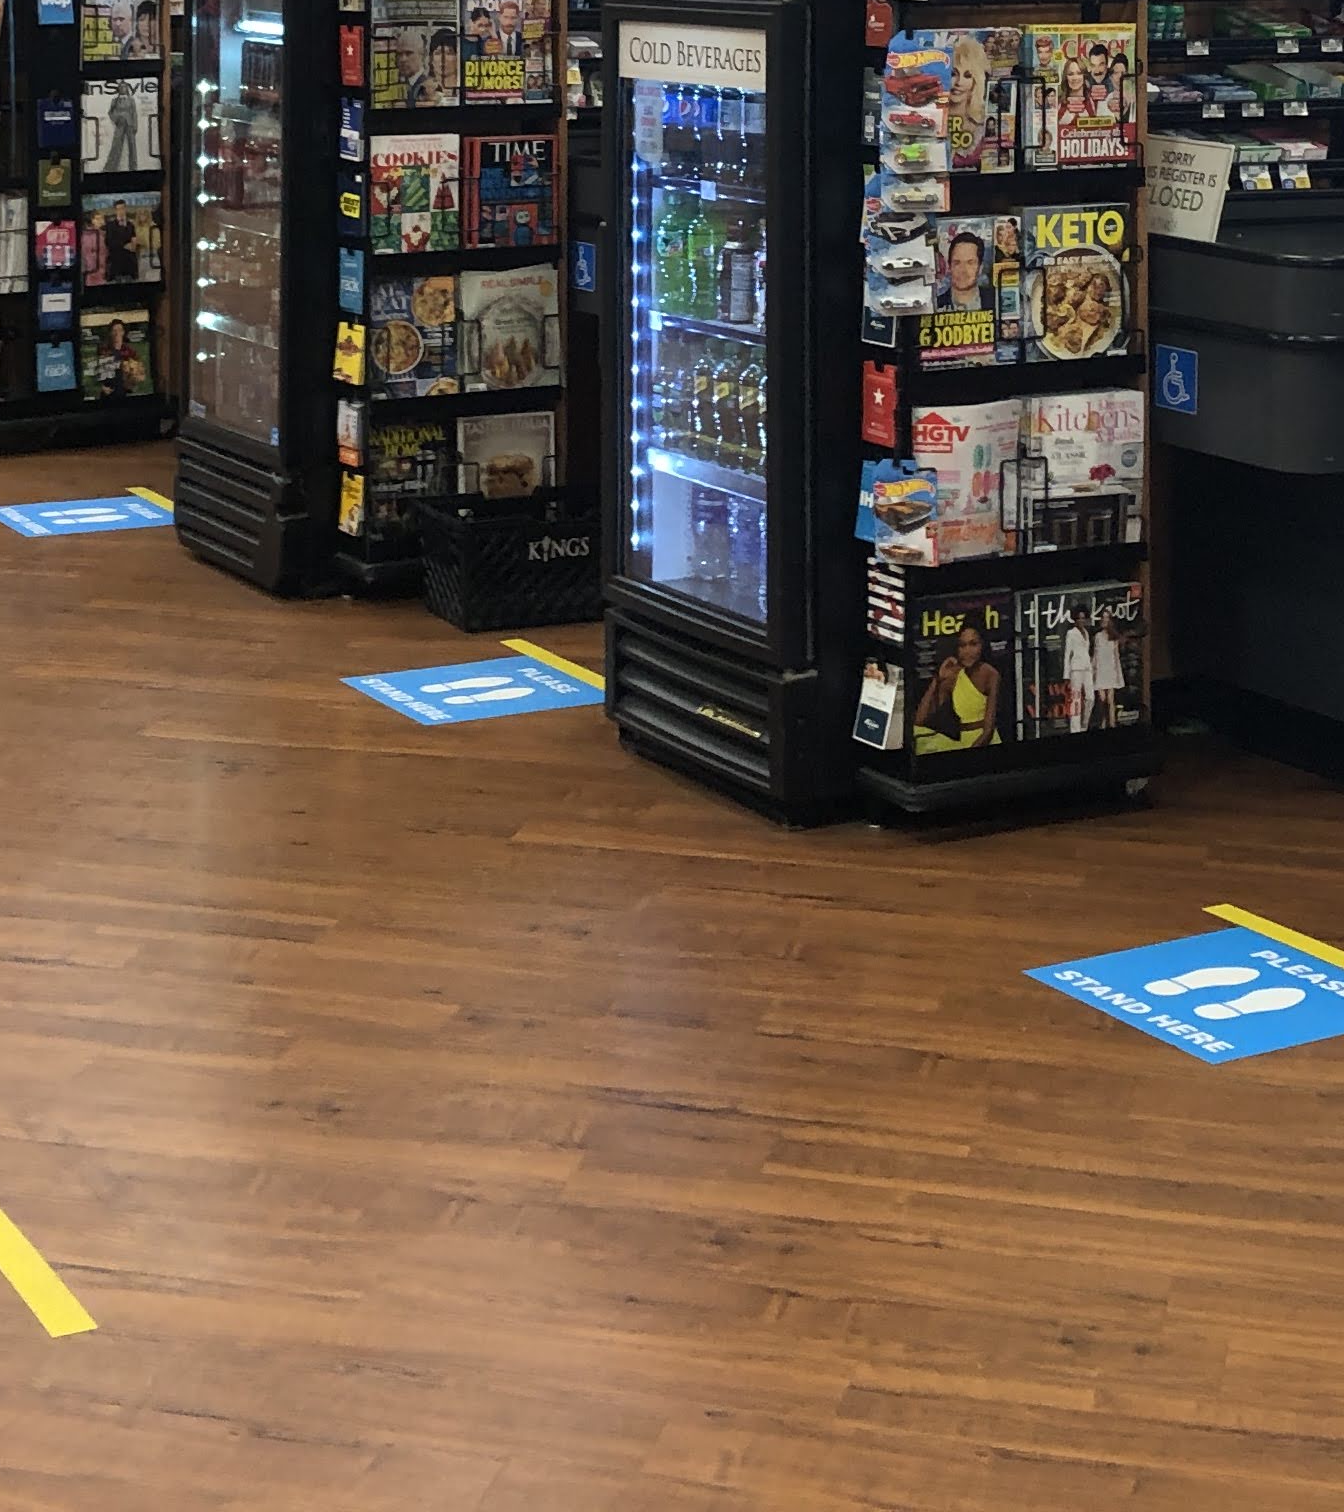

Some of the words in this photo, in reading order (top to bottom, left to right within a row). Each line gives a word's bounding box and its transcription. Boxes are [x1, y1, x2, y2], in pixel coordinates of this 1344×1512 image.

[629, 36, 672, 65] COLD
[676, 39, 762, 74] BEVERAGES
[1060, 33, 1131, 58] cler
[465, 61, 524, 76] DIVORCE
[84, 78, 159, 96] InSyle
[371, 150, 459, 168] COOKIES
[488, 140, 547, 163] TIME
[1059, 136, 1130, 160] HOLIDAYS!
[1160, 150, 1197, 167] SORRY
[1159, 167, 1207, 186] REGISTER
[1208, 173, 1218, 188] IS
[1035, 210, 1126, 250] KETO
[1036, 399, 1142, 435] Kitchens
[913, 425, 971, 443] HGTV
[527, 536, 591, 563] KINGS
[922, 604, 1000, 637] Heh
[516, 666, 581, 695] PLEASE
[1053, 969, 1154, 1016] STAND
[1146, 1013, 1235, 1055] HERE
